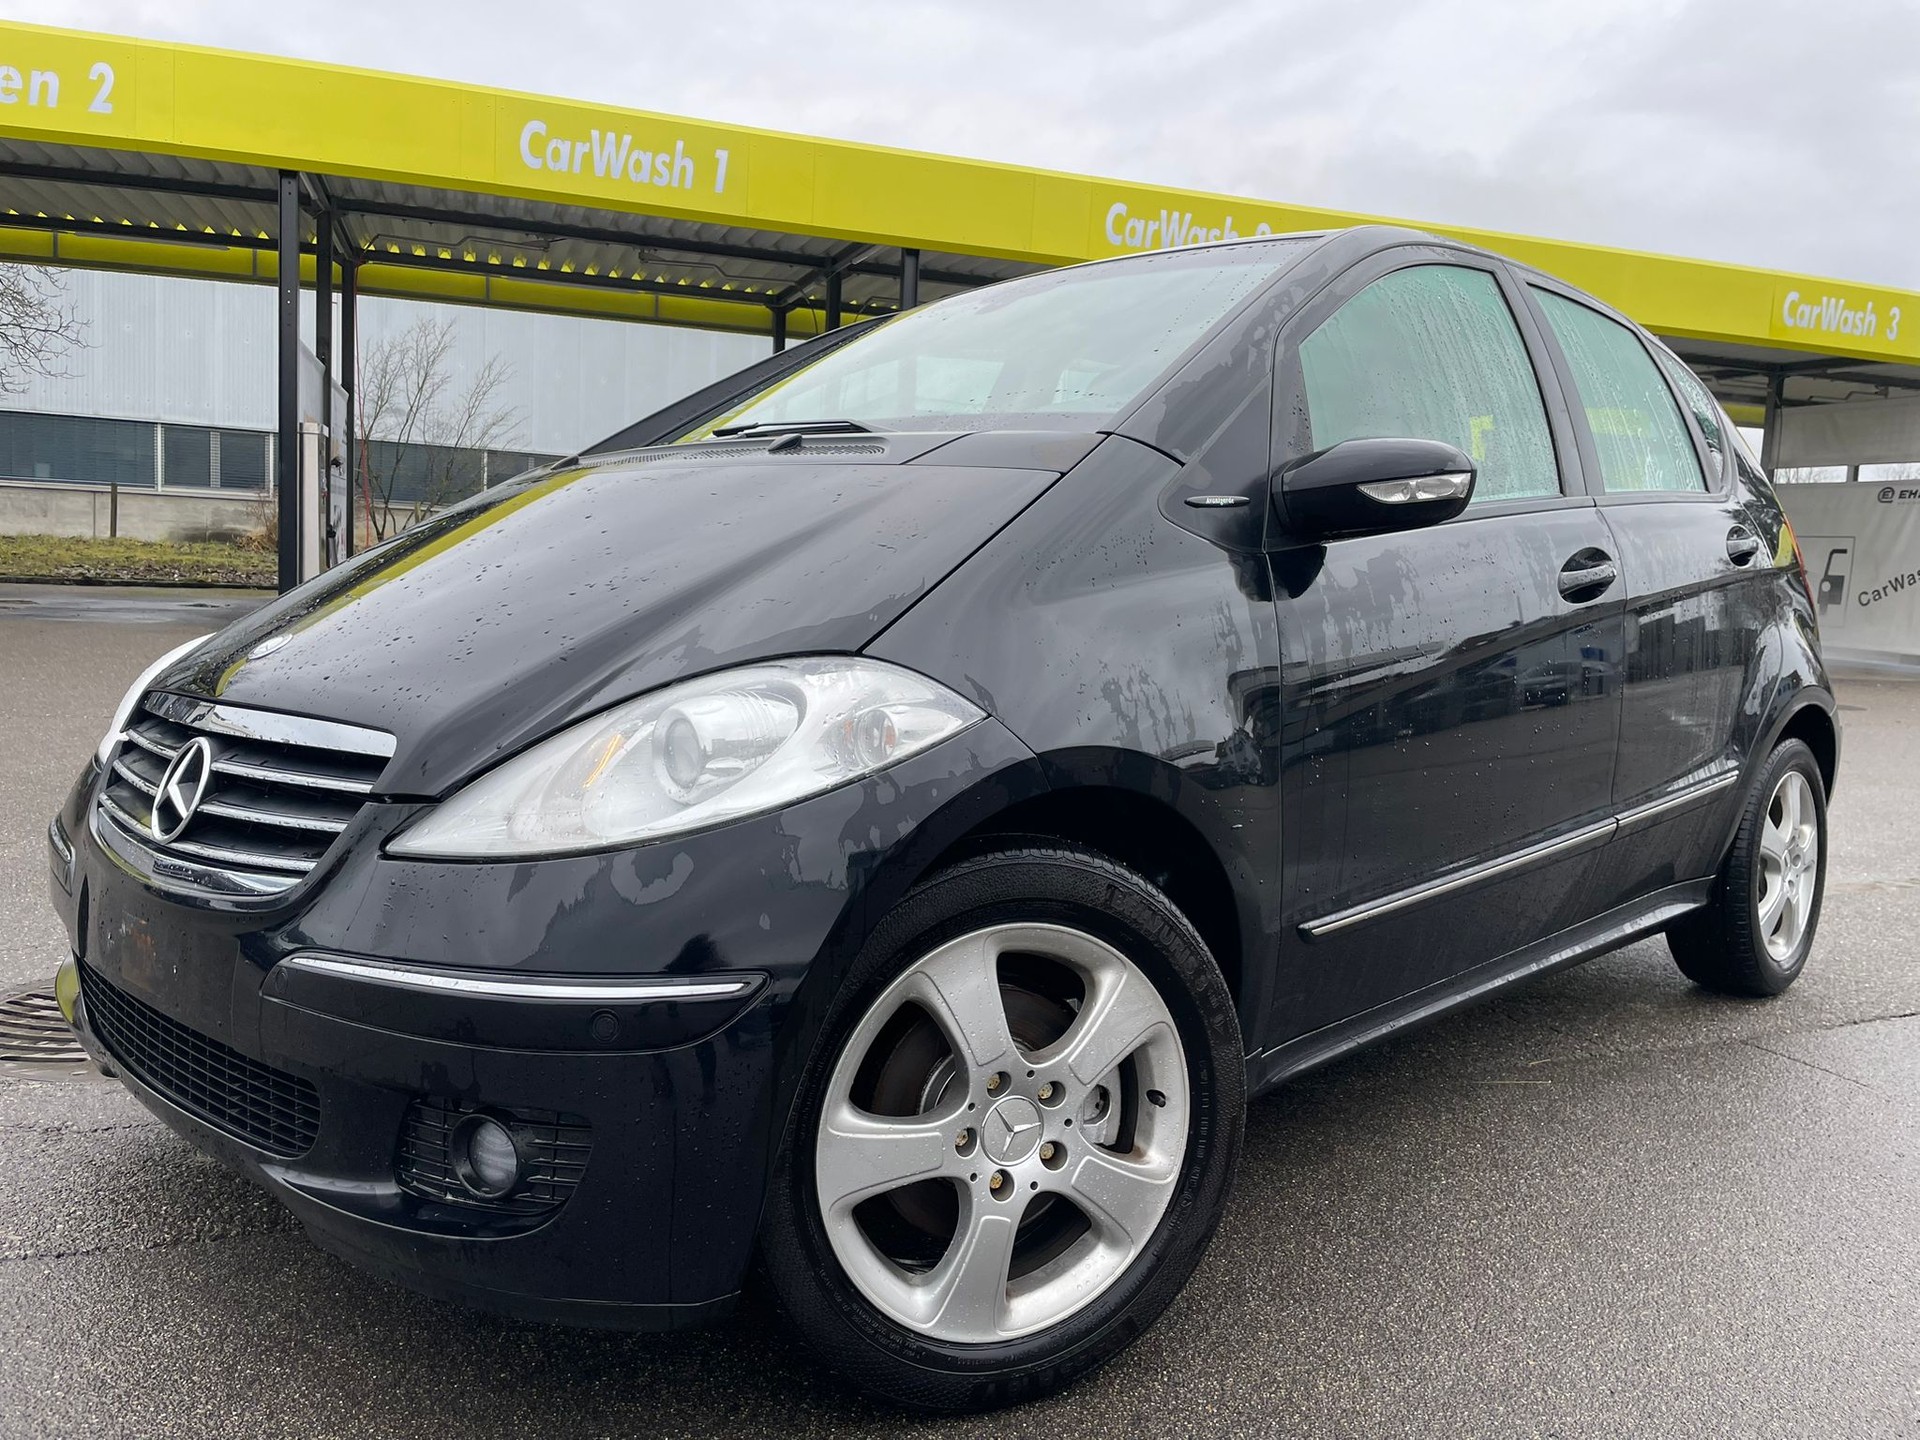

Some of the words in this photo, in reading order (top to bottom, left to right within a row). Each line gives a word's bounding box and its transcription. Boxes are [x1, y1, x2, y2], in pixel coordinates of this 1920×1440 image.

[0, 65, 60, 109] en
[87, 60, 115, 115] 2
[519, 119, 695, 190] CarWash
[713, 148, 730, 194] 1
[1782, 290, 1878, 338] CarWash
[1886, 305, 1901, 341] 3
[1898, 489, 1920, 500] EH
